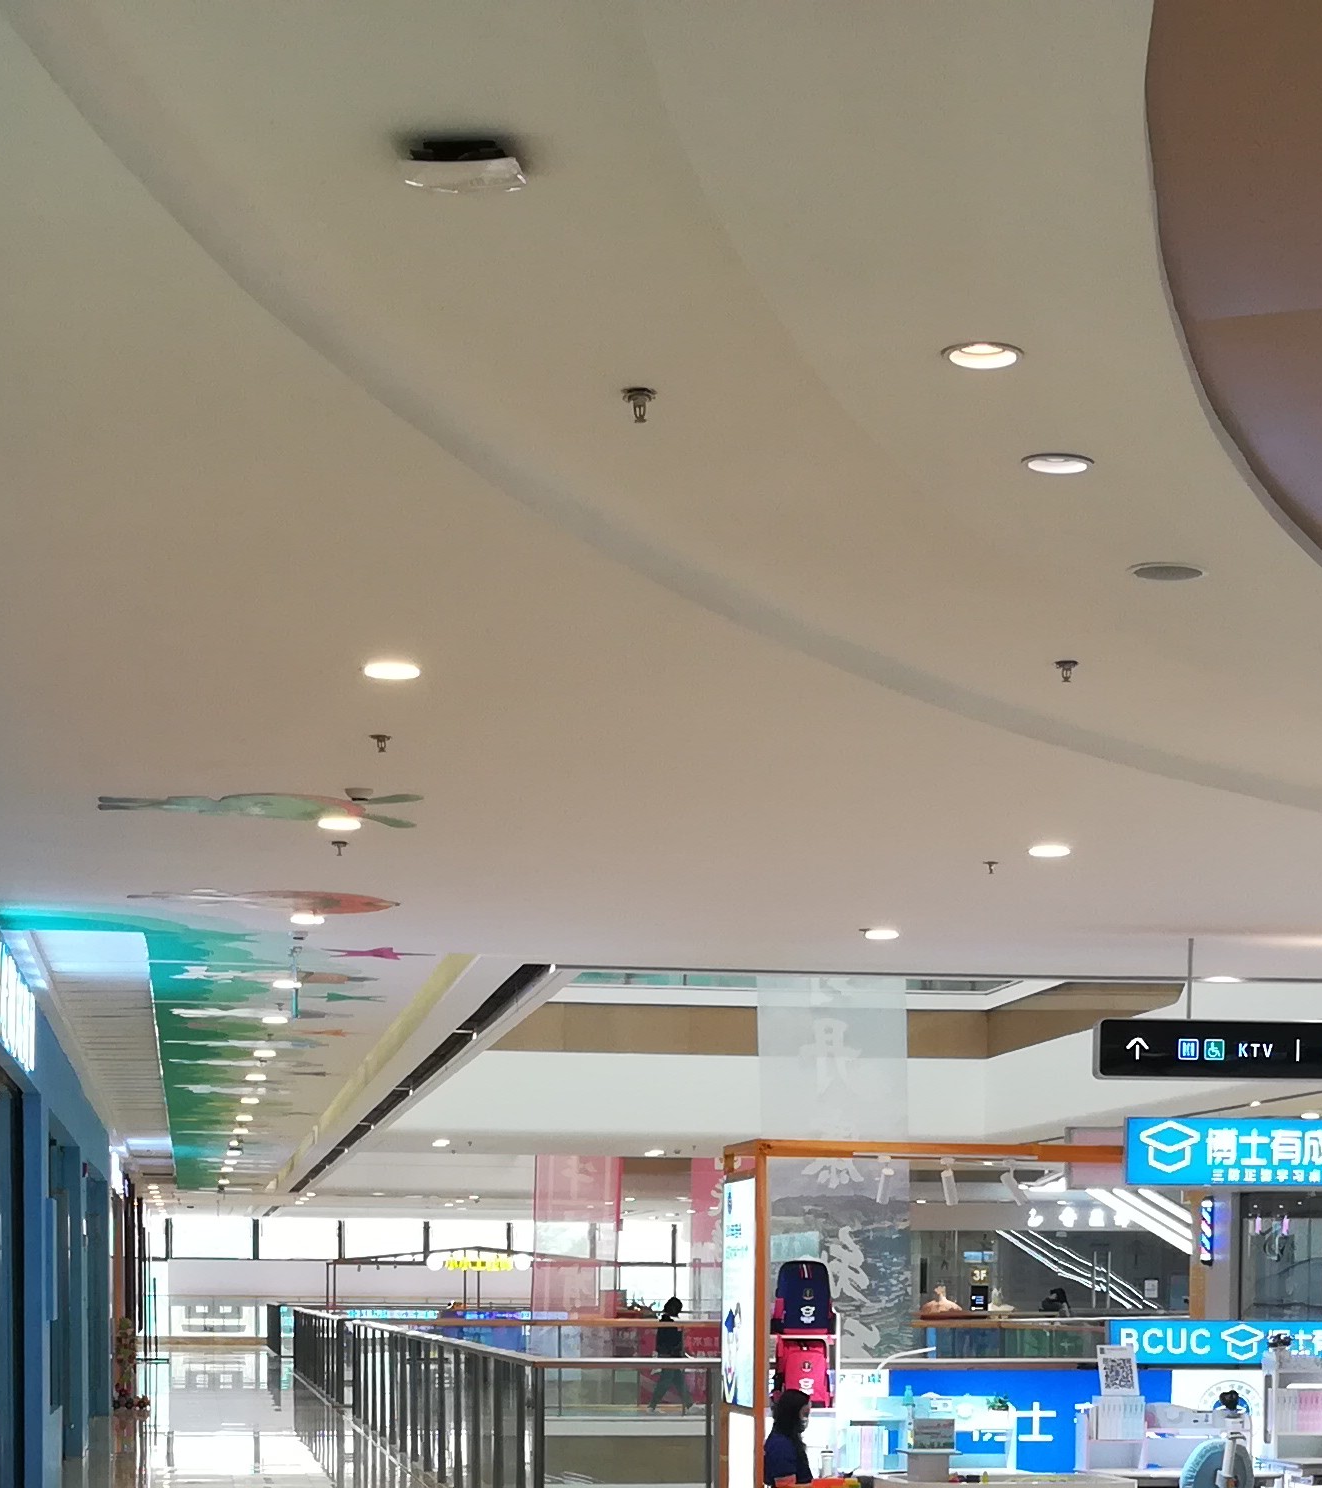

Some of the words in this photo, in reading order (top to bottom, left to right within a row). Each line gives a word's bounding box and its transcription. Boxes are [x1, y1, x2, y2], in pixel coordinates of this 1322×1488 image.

[1238, 1043, 1274, 1058] KTV
[972, 1269, 988, 1281] 3F
[1120, 1328, 1211, 1355] BCUC
